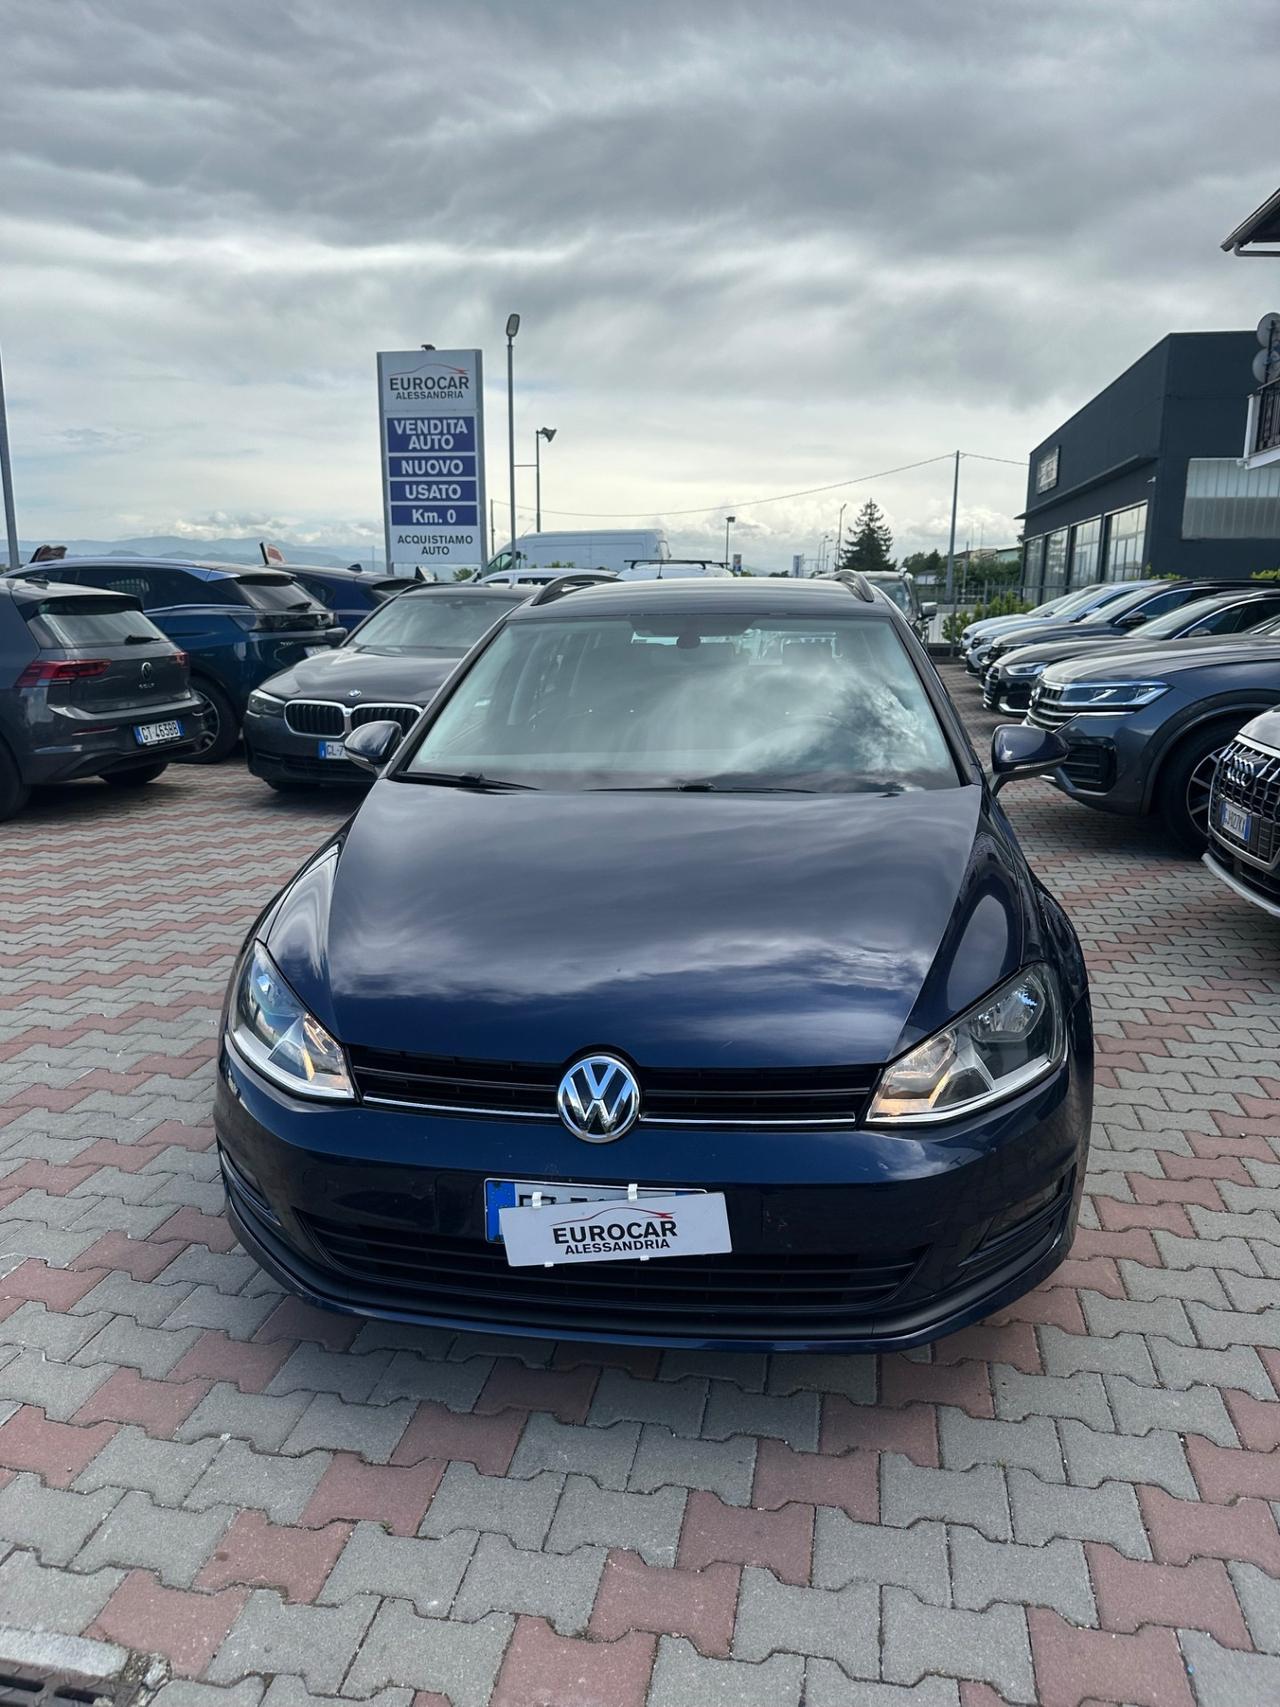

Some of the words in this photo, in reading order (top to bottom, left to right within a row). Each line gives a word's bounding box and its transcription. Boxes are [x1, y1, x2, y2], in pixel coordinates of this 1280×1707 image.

[390, 376, 470, 391] EUROCAR
[395, 391, 464, 400] ALESSANDRIA
[394, 419, 468, 435] VENDITA
[408, 435, 455, 450] AUTO
[401, 459, 464, 475] NUOVO
[405, 484, 462, 499] USATO
[411, 508, 443, 524] Km.
[446, 508, 457, 523] 0
[397, 534, 474, 545] ACQUISTIAMO
[421, 545, 451, 556] AUTO
[552, 1219, 678, 1245] EUROCAR
[564, 1238, 671, 1256] ALESSANDRIA
